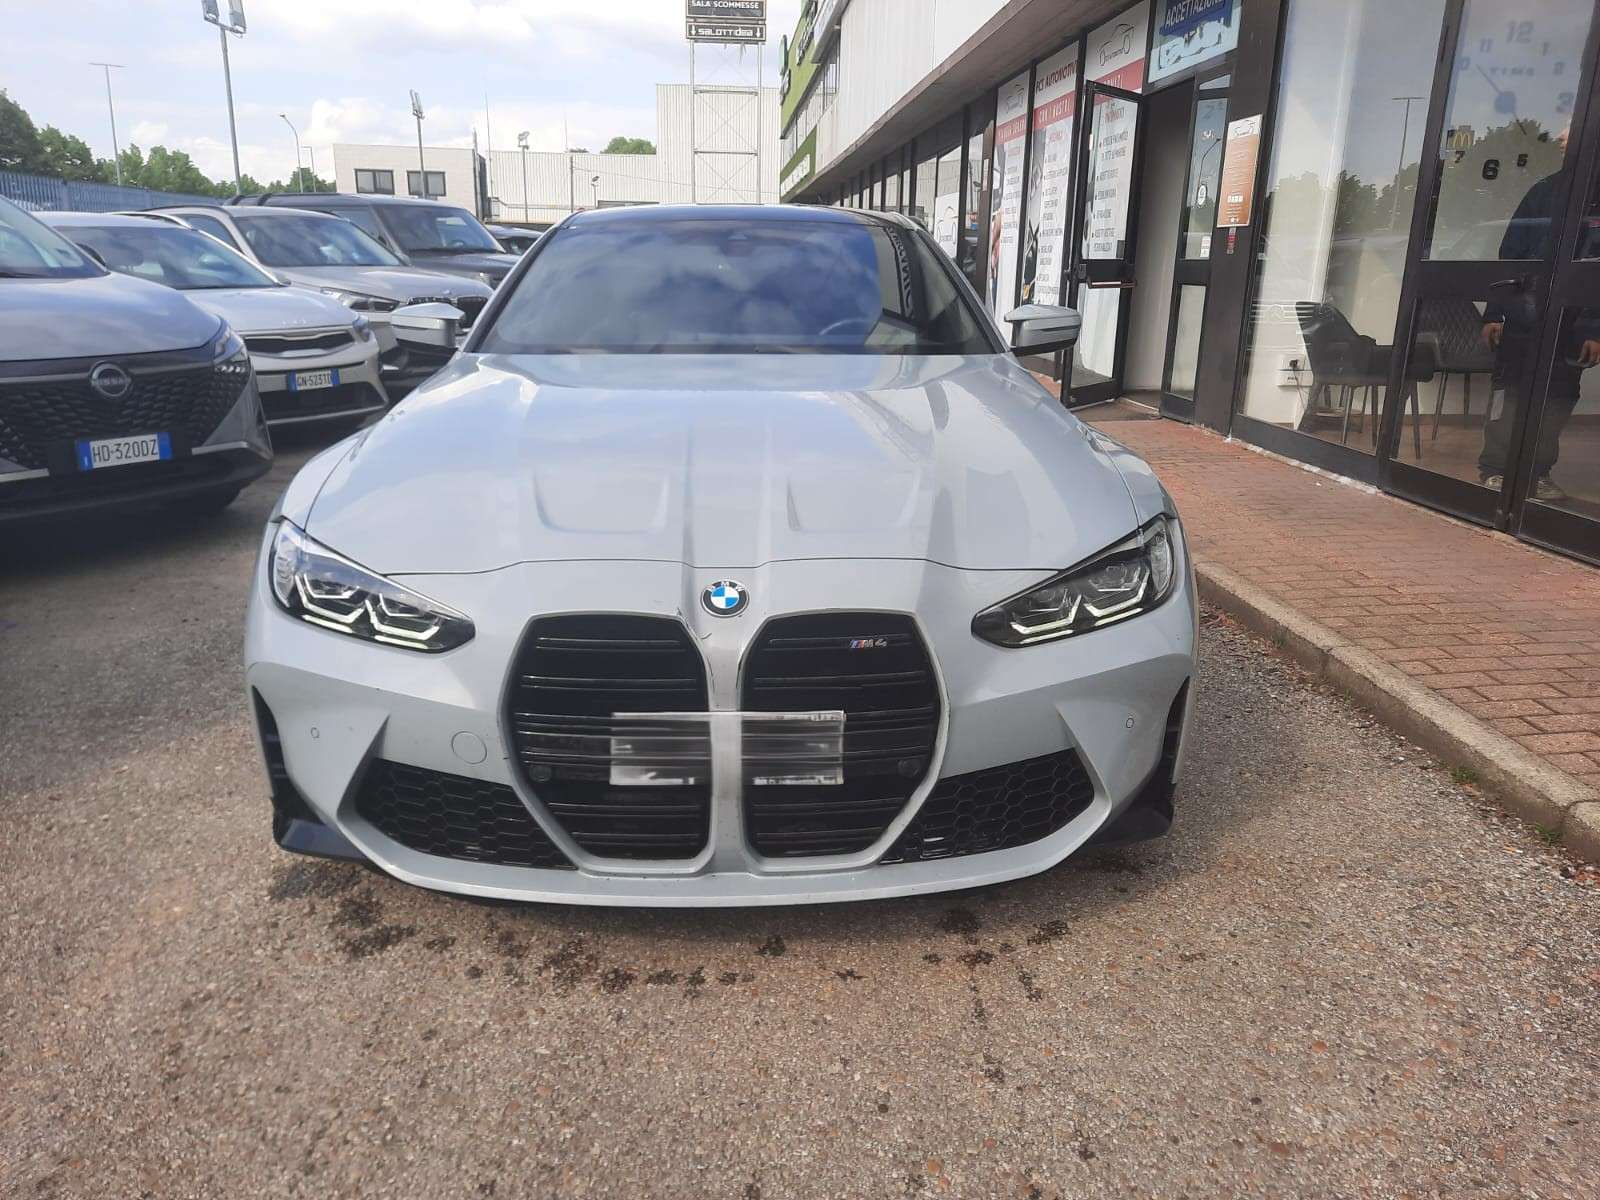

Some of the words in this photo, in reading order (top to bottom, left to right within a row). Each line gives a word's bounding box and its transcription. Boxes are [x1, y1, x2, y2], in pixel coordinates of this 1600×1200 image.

[714, 0, 759, 9] SCOMMESSE
[1164, 0, 1222, 29] ACCETTAZI
[1506, 21, 1534, 43] 12
[1480, 38, 1493, 53] 11
[1455, 150, 1465, 163] 7
[1517, 154, 1528, 167] 5
[1482, 159, 1500, 180] 6
[704, 580, 746, 591] BMW
[856, 638, 888, 649] M4
